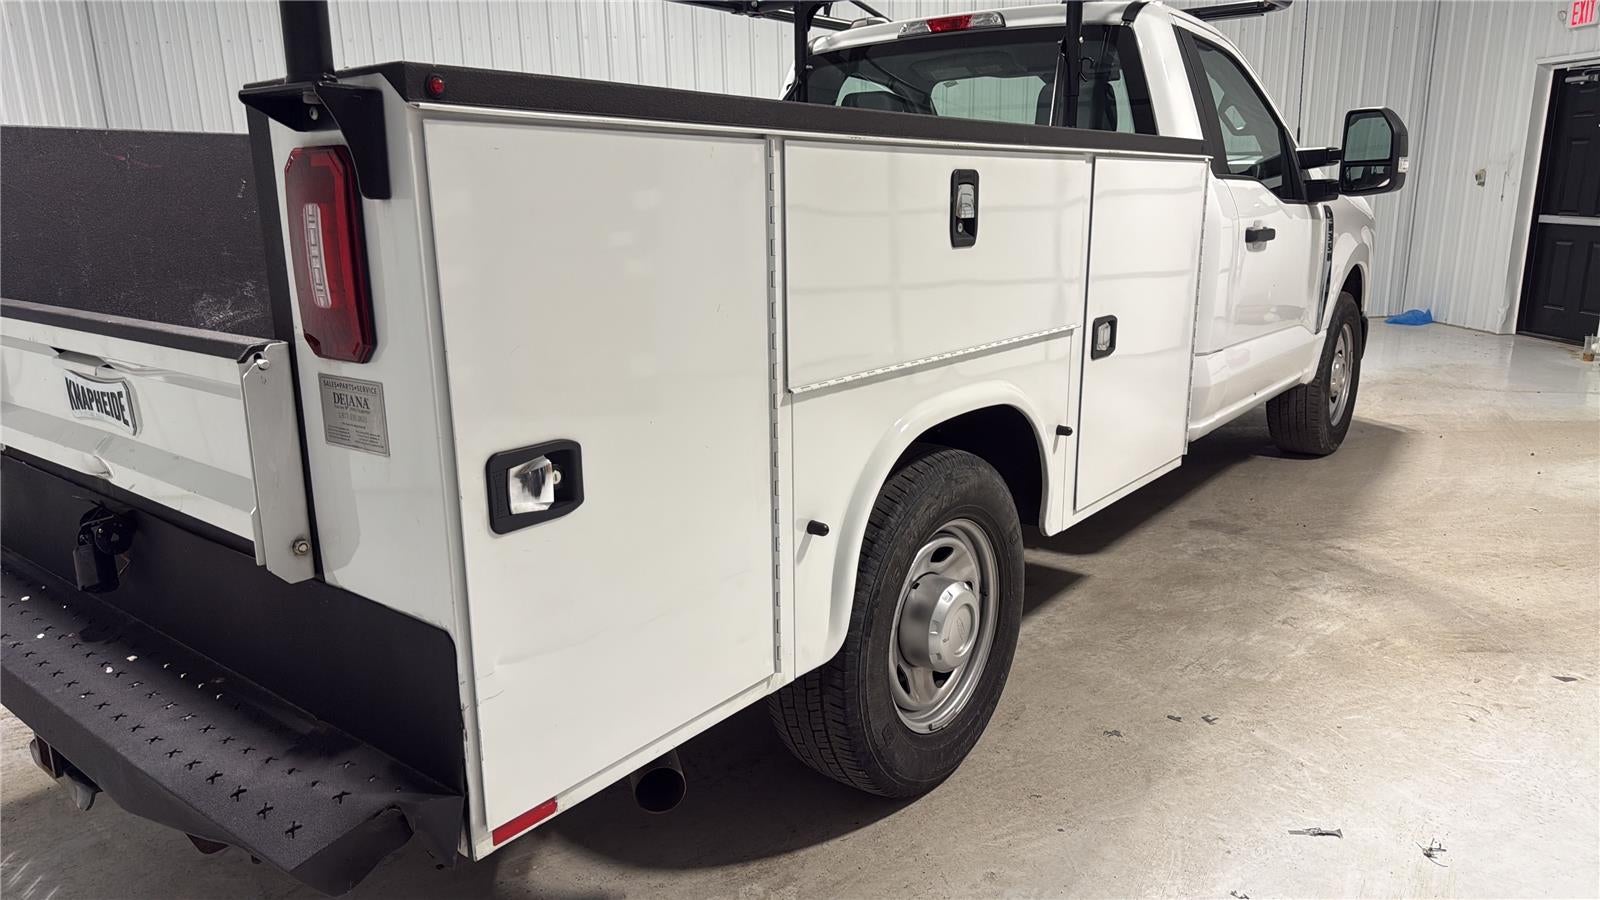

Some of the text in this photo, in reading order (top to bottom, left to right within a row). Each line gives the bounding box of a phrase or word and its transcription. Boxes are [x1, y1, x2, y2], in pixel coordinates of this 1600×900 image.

[1571, 0, 1595, 26] EXIT
[65, 376, 130, 427] KNAPHEIDE
[333, 391, 370, 410] DEJANA
